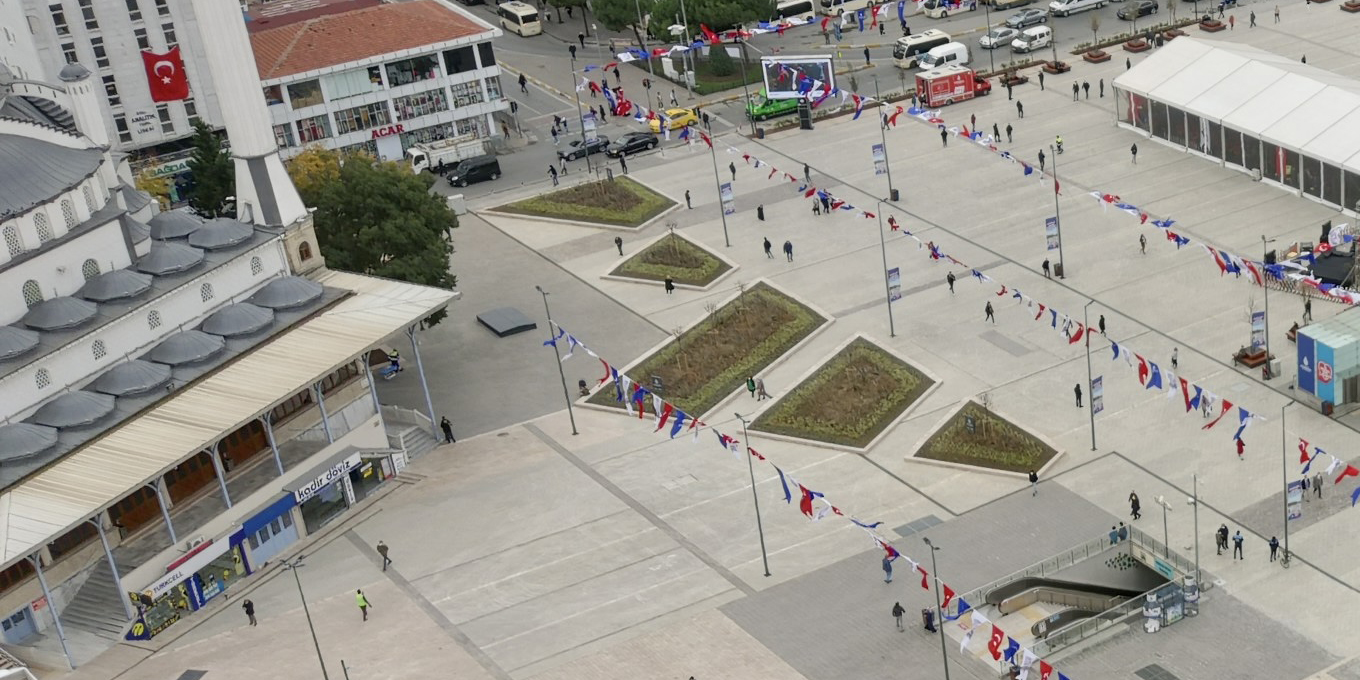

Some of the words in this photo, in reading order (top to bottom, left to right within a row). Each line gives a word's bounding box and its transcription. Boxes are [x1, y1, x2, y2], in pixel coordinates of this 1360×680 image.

[372, 124, 405, 139] ACAR
[299, 477, 324, 499] kadir
[153, 571, 184, 594] TURKCELL
